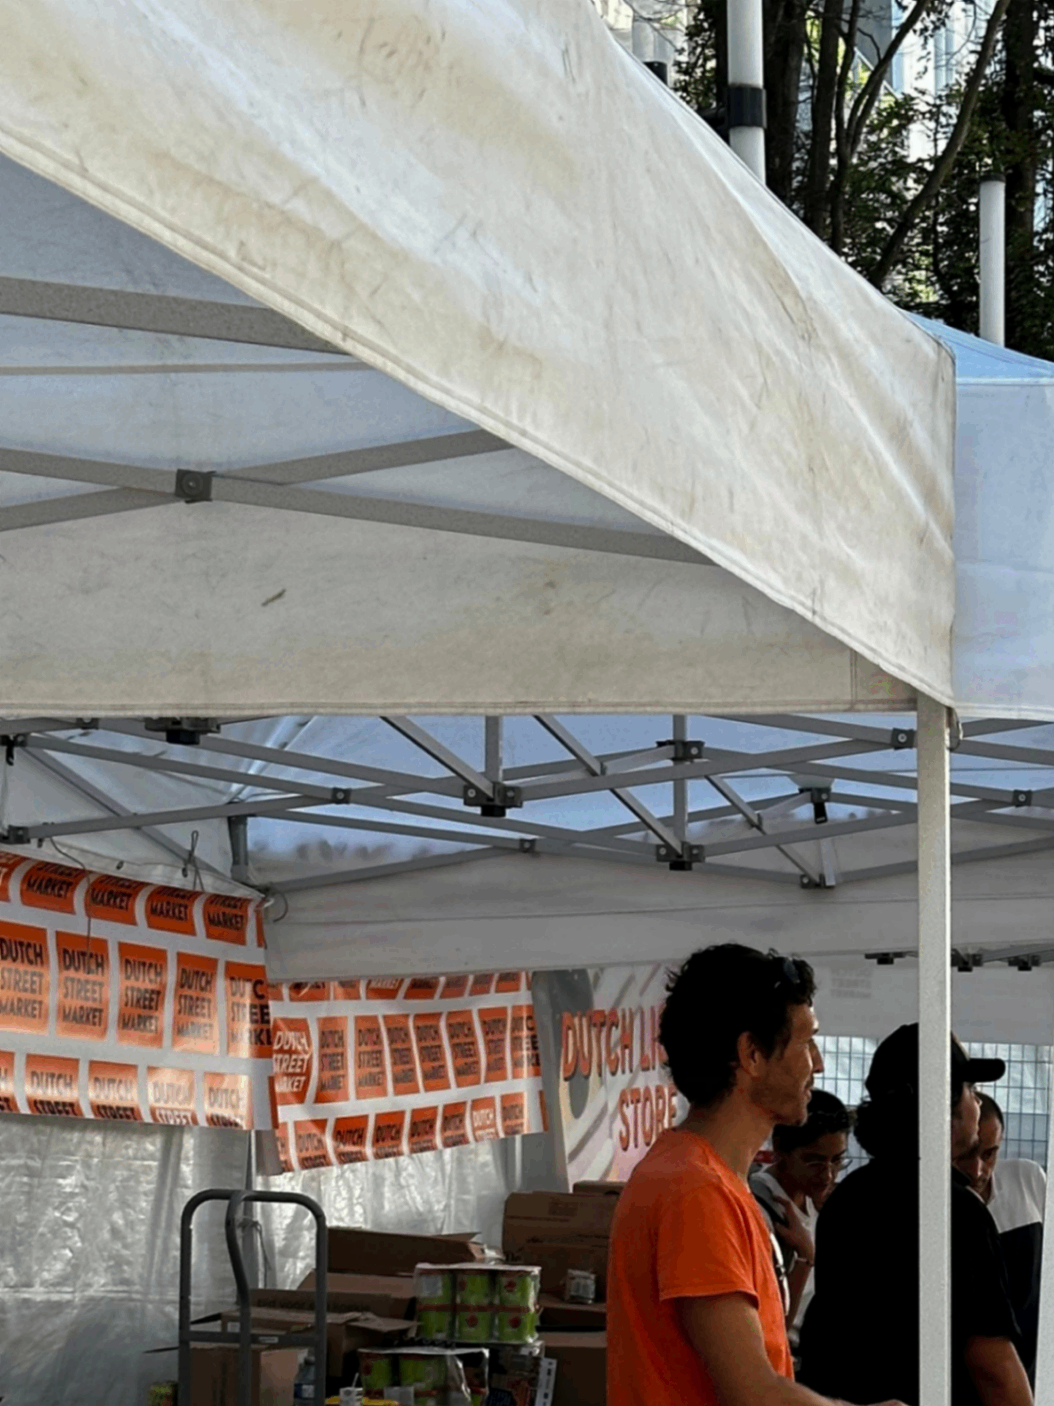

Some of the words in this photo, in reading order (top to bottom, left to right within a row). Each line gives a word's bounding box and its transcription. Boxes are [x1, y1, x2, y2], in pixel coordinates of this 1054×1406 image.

[26, 876, 73, 899] MARKET
[90, 888, 132, 911] MARKET
[150, 900, 188, 921] MARKET
[207, 911, 244, 931] MARKET
[0, 937, 44, 966] DUTCH
[62, 947, 104, 976] DUTCH
[0, 966, 43, 995] STREET
[124, 958, 163, 986] DUTCH
[180, 967, 214, 993] DUTCH
[63, 976, 104, 1005] STREET
[124, 986, 161, 1012] STREET
[62, 1004, 103, 1027] MARKET
[178, 994, 212, 1019] STREET
[121, 1013, 159, 1034] MARKET
[562, 1008, 634, 1081] DUTCH
[31, 1070, 73, 1096] DUTCH
[93, 1075, 133, 1101] DUTCH
[618, 1083, 677, 1151] STORE
